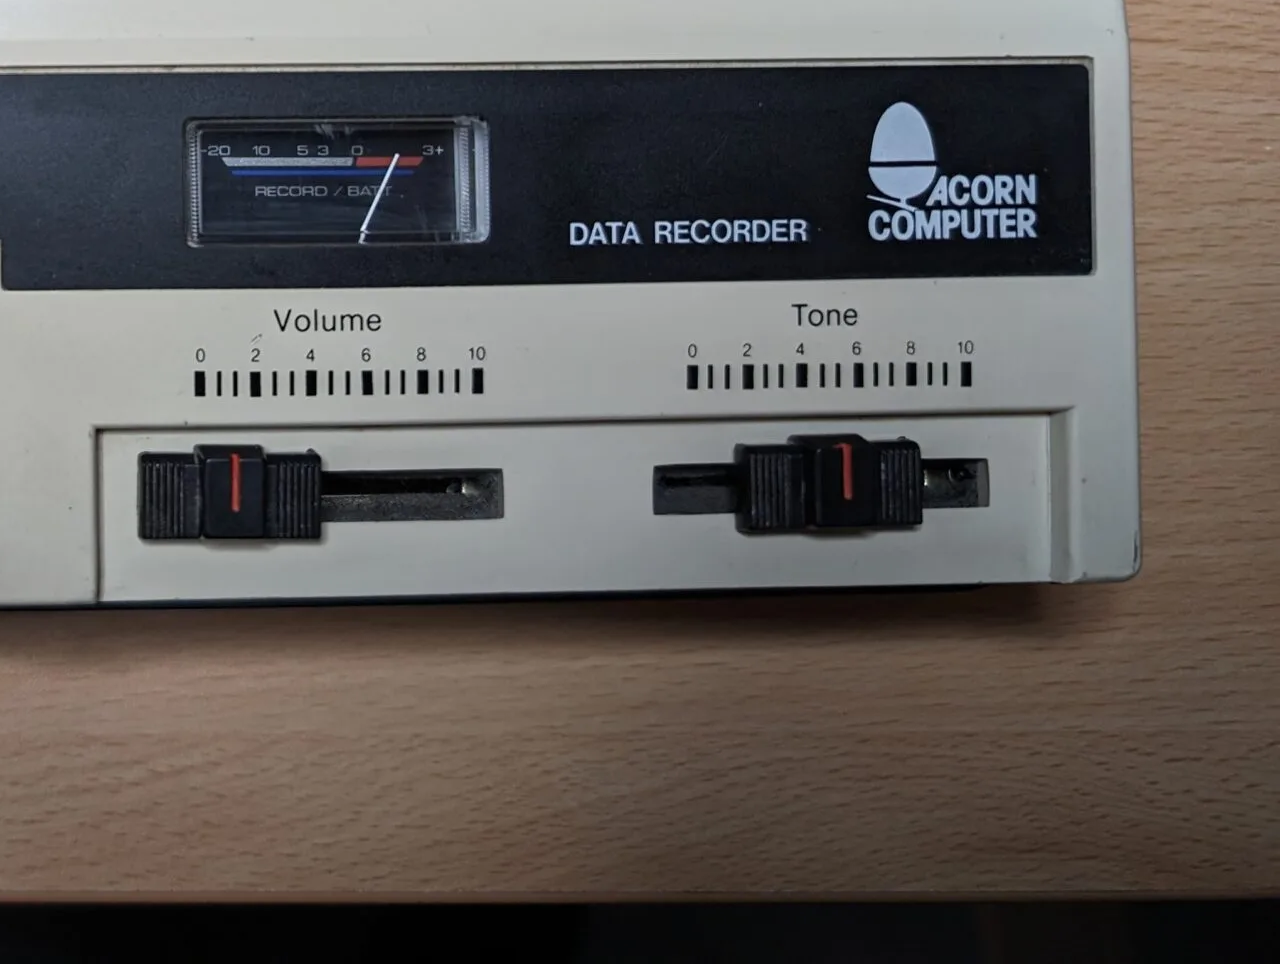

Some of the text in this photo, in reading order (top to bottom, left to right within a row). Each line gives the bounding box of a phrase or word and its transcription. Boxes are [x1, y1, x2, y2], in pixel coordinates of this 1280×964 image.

[253, 145, 270, 156] 10
[297, 145, 308, 156] 5
[318, 145, 329, 156] 3
[351, 145, 363, 156] 0
[255, 186, 328, 197] RECORD
[925, 175, 1038, 206] ACORN
[569, 219, 809, 246] DATA RECORDER
[868, 209, 1038, 242] COMPUTER
[274, 309, 382, 332] Volume
[792, 304, 858, 327] Tone
[195, 346, 487, 363] 0 2 4 6 8 10
[687, 340, 974, 358] 0 2 4 6 8 10
